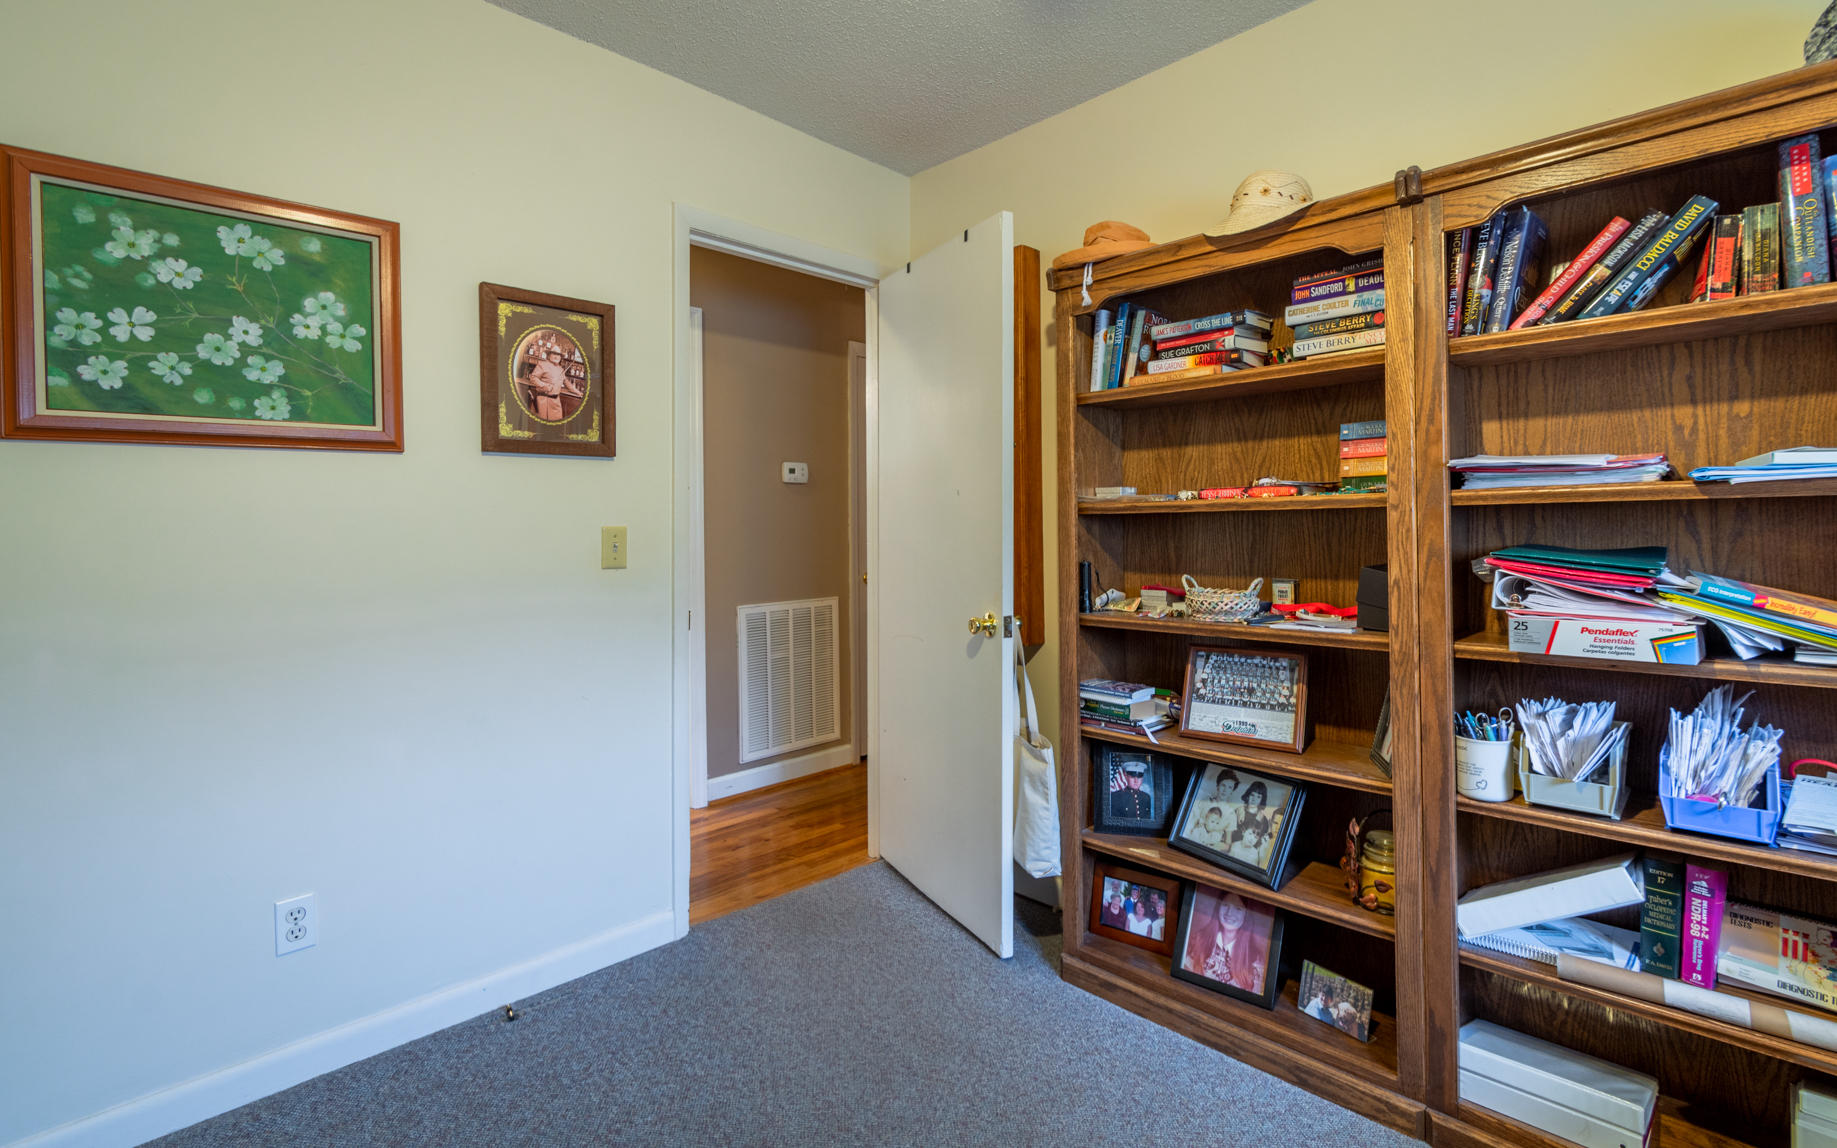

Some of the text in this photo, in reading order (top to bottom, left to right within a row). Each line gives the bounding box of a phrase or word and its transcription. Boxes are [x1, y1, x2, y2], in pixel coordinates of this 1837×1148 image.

[1674, 204, 1705, 231] DAVID
[1480, 221, 1490, 243] EVE
[1803, 198, 1817, 259] OUTLANDISH
[1452, 231, 1462, 255] INCE
[1580, 232, 1613, 264] PRESTON
[1636, 230, 1679, 271] BALDACCI
[1603, 238, 1634, 267] JACKSON
[1358, 274, 1385, 287] DEADL
[1550, 269, 1577, 293] CHILD
[1295, 281, 1343, 300] JOHN SANDFORD
[1605, 279, 1633, 305] ESCAPE
[1288, 305, 1320, 317] CATHERINE
[1322, 299, 1349, 311] COULTER
[1353, 296, 1385, 308] FINAL CU
[1195, 315, 1233, 330] CROSS THE LINE
[1308, 321, 1337, 332] STEVE
[1339, 314, 1371, 326] BERRY
[1115, 319, 1124, 345] DEAVER
[1161, 350, 1175, 359] SUE
[1176, 343, 1210, 356] GRAFTON
[1296, 336, 1357, 352] STEVE BERRY
[1153, 360, 1187, 372] LISA GARDNER
[1513, 620, 1528, 631] 25
[1580, 626, 1639, 637] Pendaflex
[1593, 636, 1635, 646] Essentials
[1649, 868, 1674, 878] EDITION
[1657, 876, 1666, 884] 17
[1647, 894, 1673, 906] Taber's
[1644, 917, 1676, 930] DICTIONARY
[1649, 911, 1673, 922] MEDICAL
[1690, 897, 1702, 937] NDR-98
[1729, 911, 1774, 928] DIAGNOSTIC
[1730, 919, 1752, 929] TESTS
[1701, 925, 1709, 939] A-Z
[1776, 979, 1829, 1003] DIAGNOSTIC
